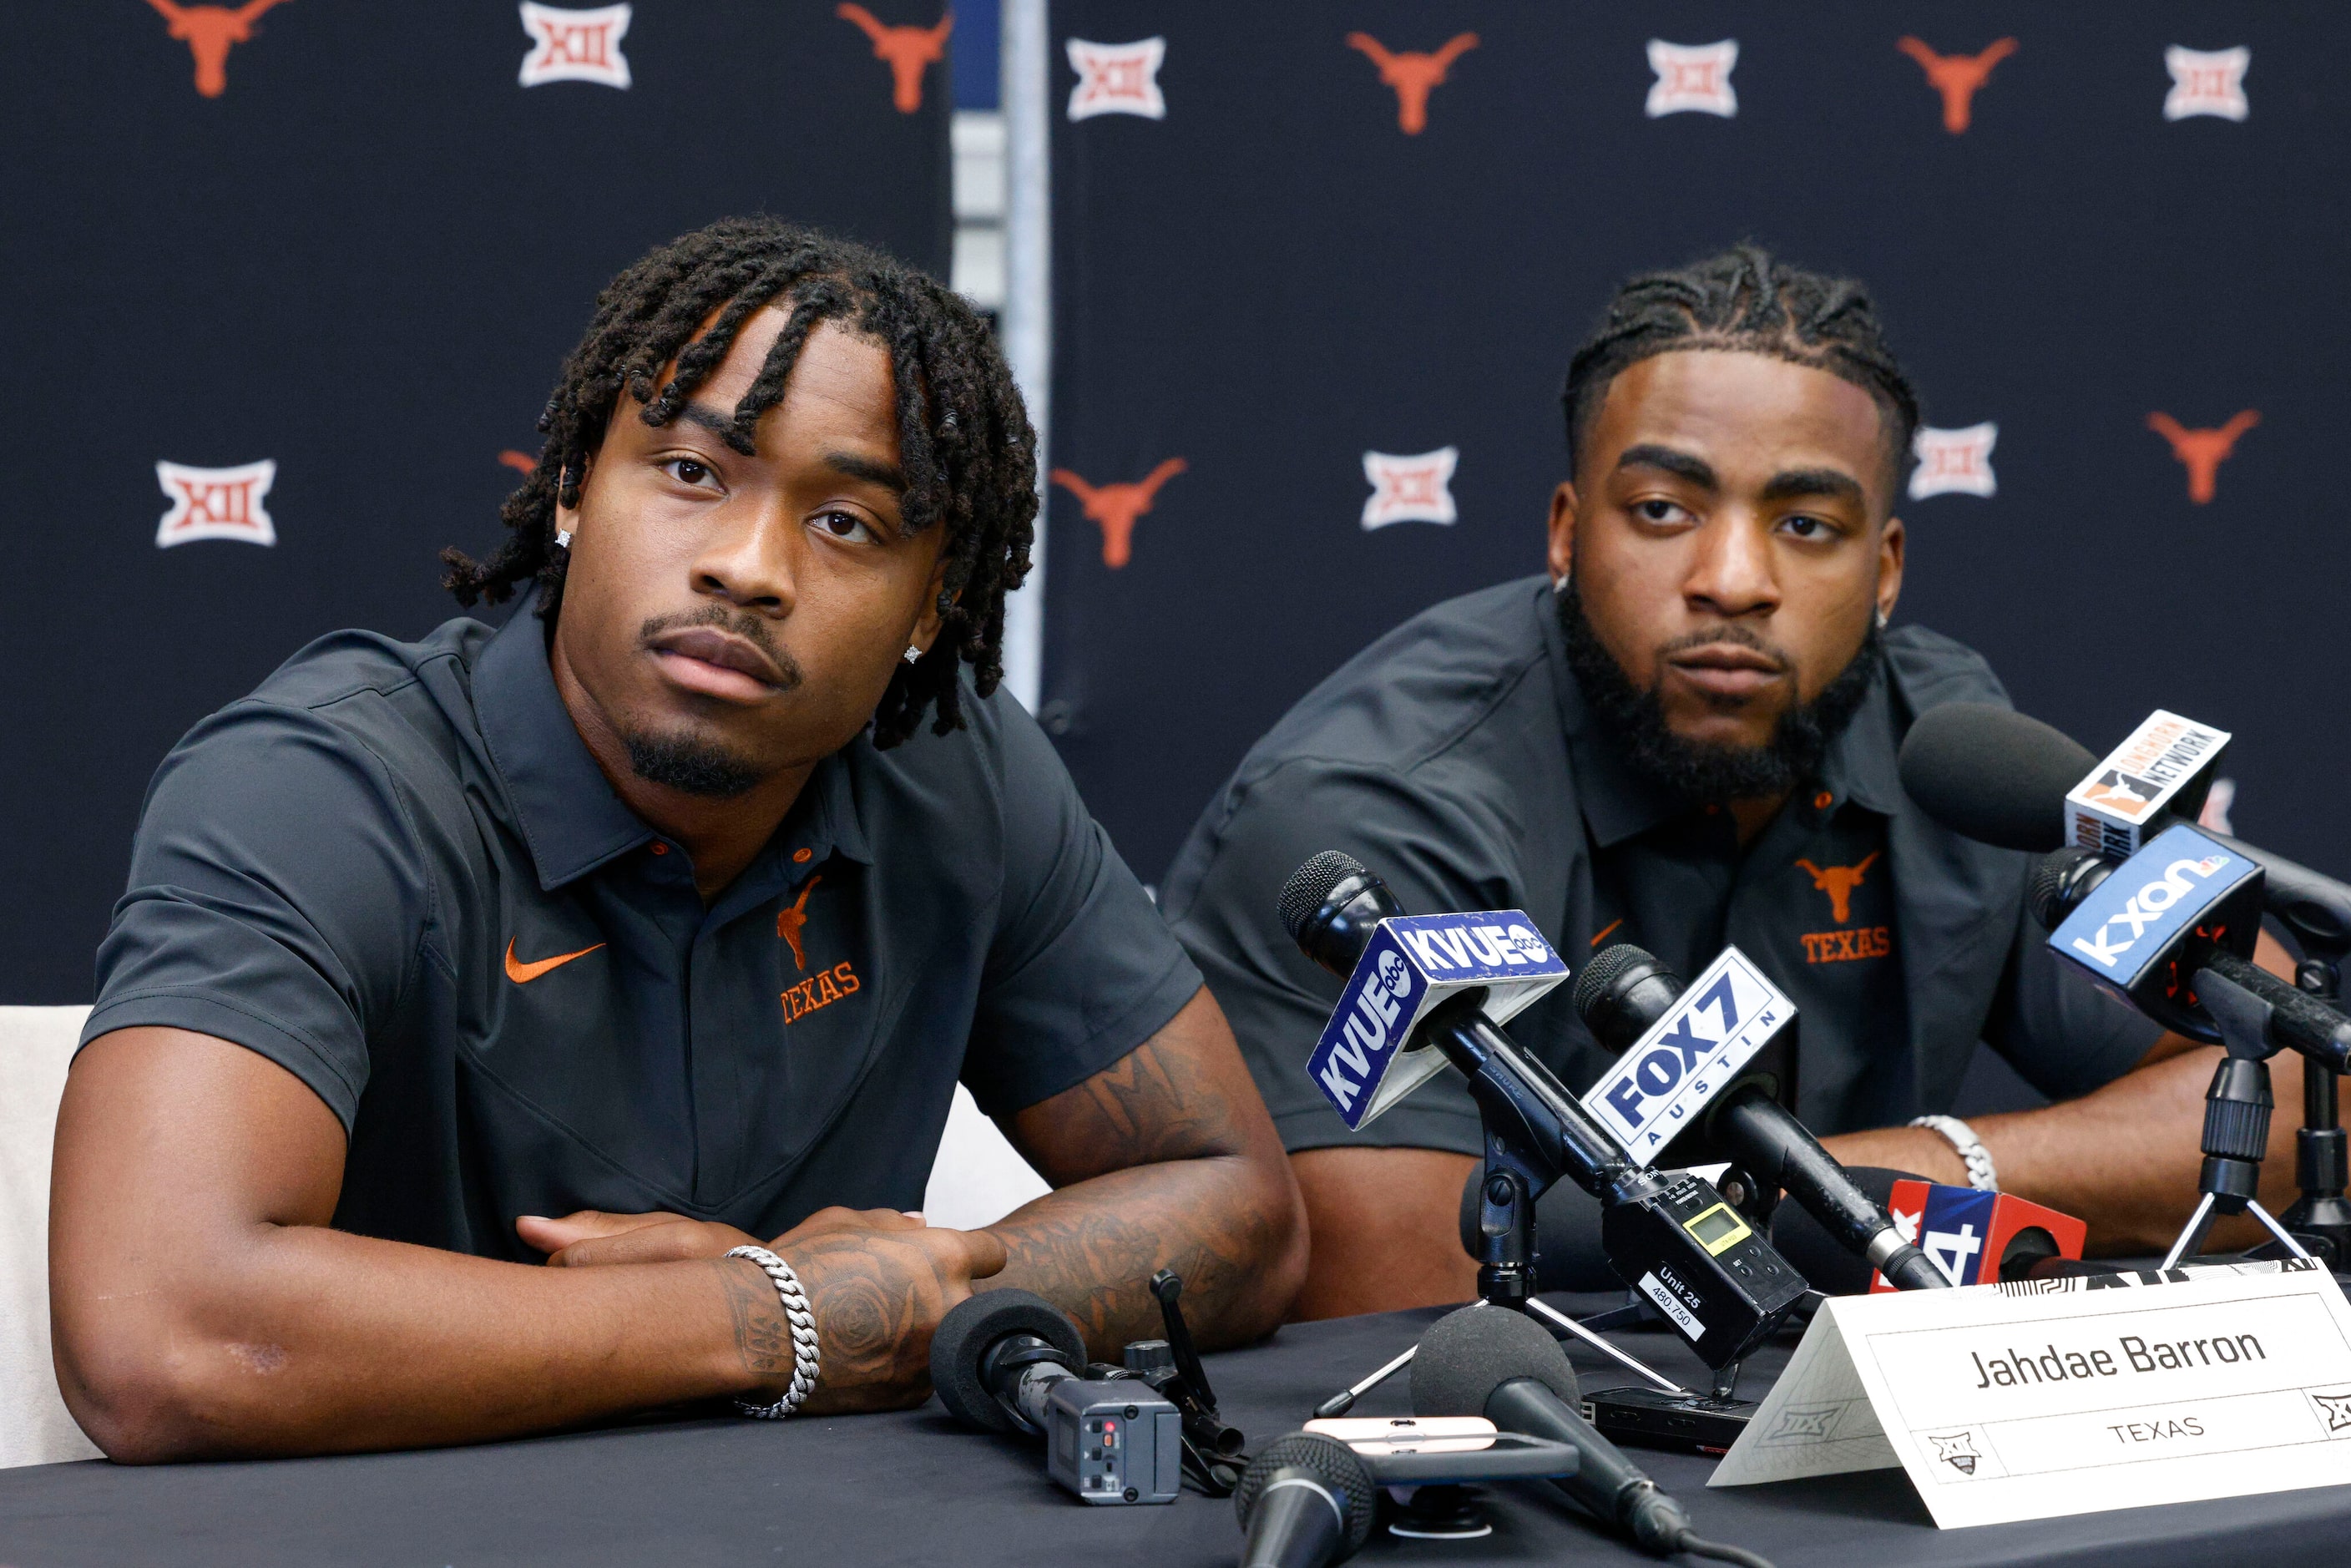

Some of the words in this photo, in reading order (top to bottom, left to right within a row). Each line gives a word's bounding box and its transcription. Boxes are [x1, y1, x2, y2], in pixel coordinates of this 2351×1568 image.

[538, 20, 613, 72] XII
[174, 477, 259, 531] XII
[2114, 721, 2187, 776] LONGHORN
[2141, 728, 2217, 786] NETWORK
[1401, 925, 1529, 970] KVUE
[1800, 925, 1891, 965] TEXAS
[780, 961, 861, 1026] TEXAS
[1320, 971, 1402, 1112] KVUE
[1605, 1013, 1719, 1129] FOX
[1694, 971, 1739, 1035] 7
[1647, 1010, 1777, 1146] AUSTIN
[1652, 1287, 1691, 1327] 480.750
[1660, 1266, 1686, 1295] Unit
[1682, 1290, 1701, 1309] 25
[1970, 1343, 2118, 1389] Jahdae
[2118, 1333, 2267, 1373] Barron
[2107, 1417, 2206, 1444] TEXAS
